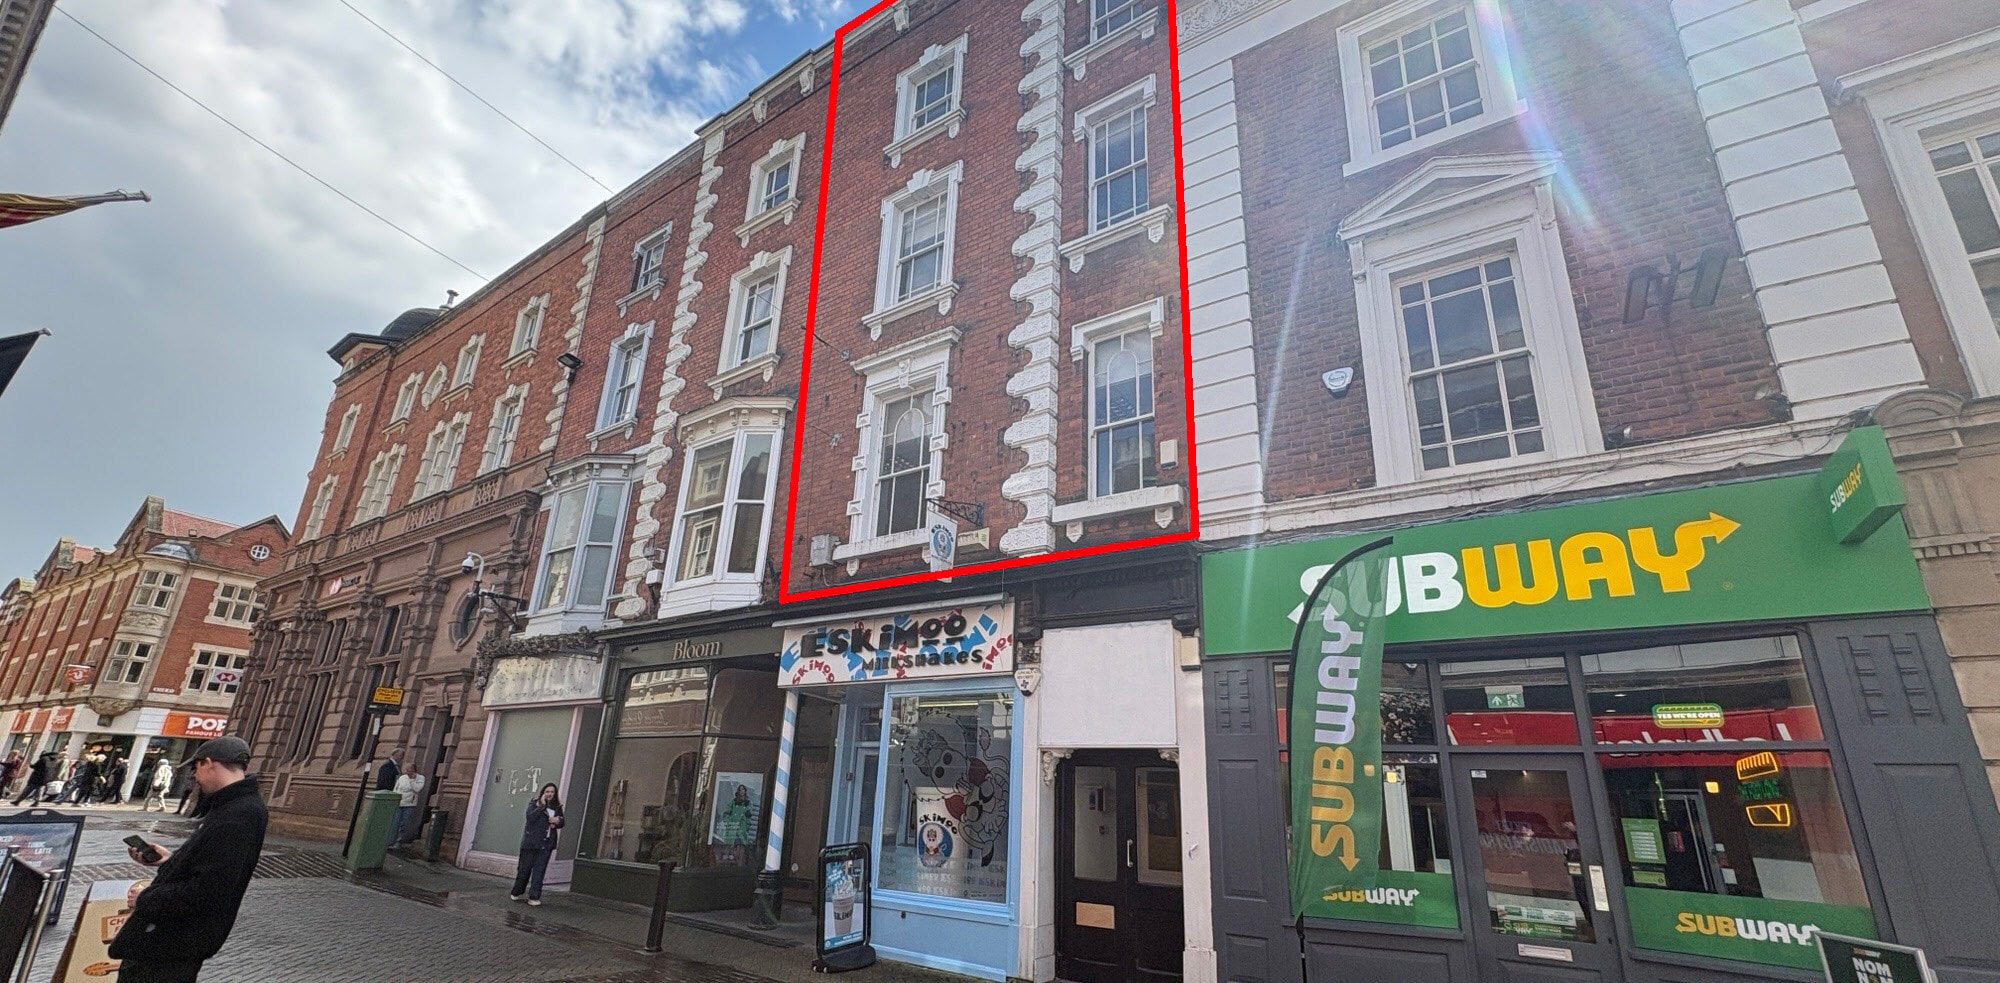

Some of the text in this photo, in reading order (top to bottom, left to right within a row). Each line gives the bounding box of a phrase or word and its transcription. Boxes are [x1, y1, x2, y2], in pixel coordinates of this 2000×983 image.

[1830, 462, 1861, 513] SUBWAY
[1287, 512, 1741, 624] SUBWAY
[673, 639, 720, 660] Bloom
[1311, 602, 1364, 871] SUBWAY
[1675, 912, 1821, 946] SUBWAY
[1852, 957, 1891, 977] NOM
